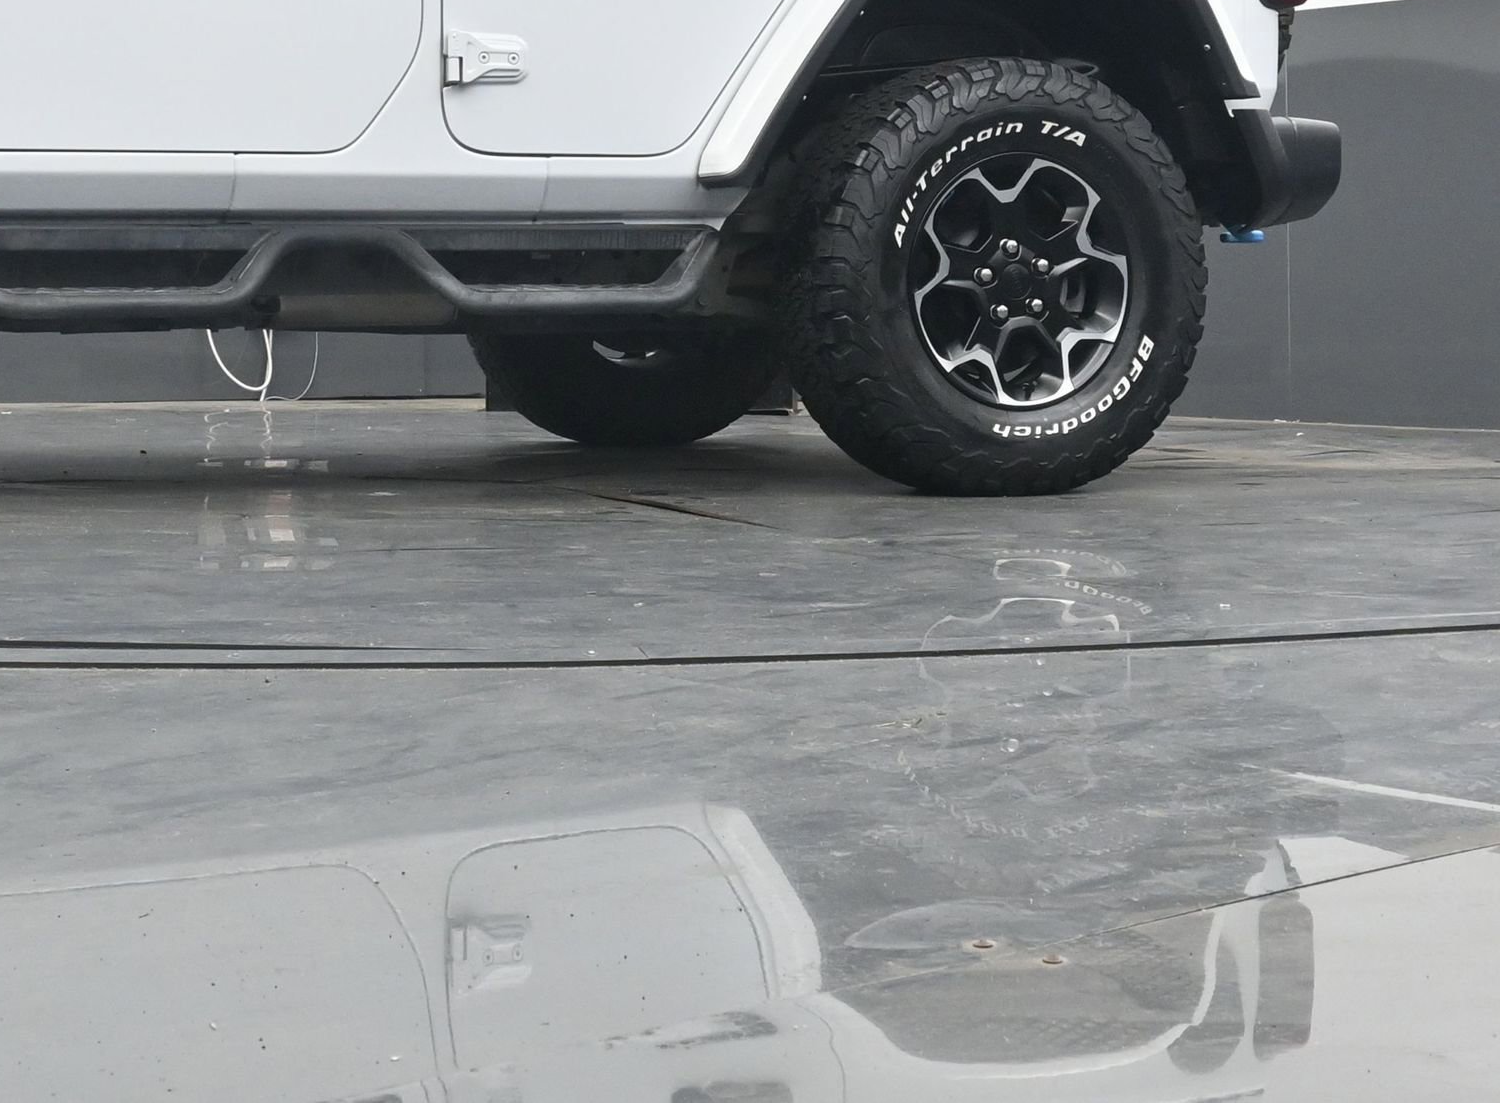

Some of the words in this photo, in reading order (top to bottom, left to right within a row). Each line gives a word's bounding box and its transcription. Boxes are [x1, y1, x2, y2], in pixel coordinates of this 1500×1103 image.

[892, 121, 1024, 249] All-Terrain
[1041, 119, 1087, 148] T/A
[991, 334, 1156, 439] BFGoodrich
